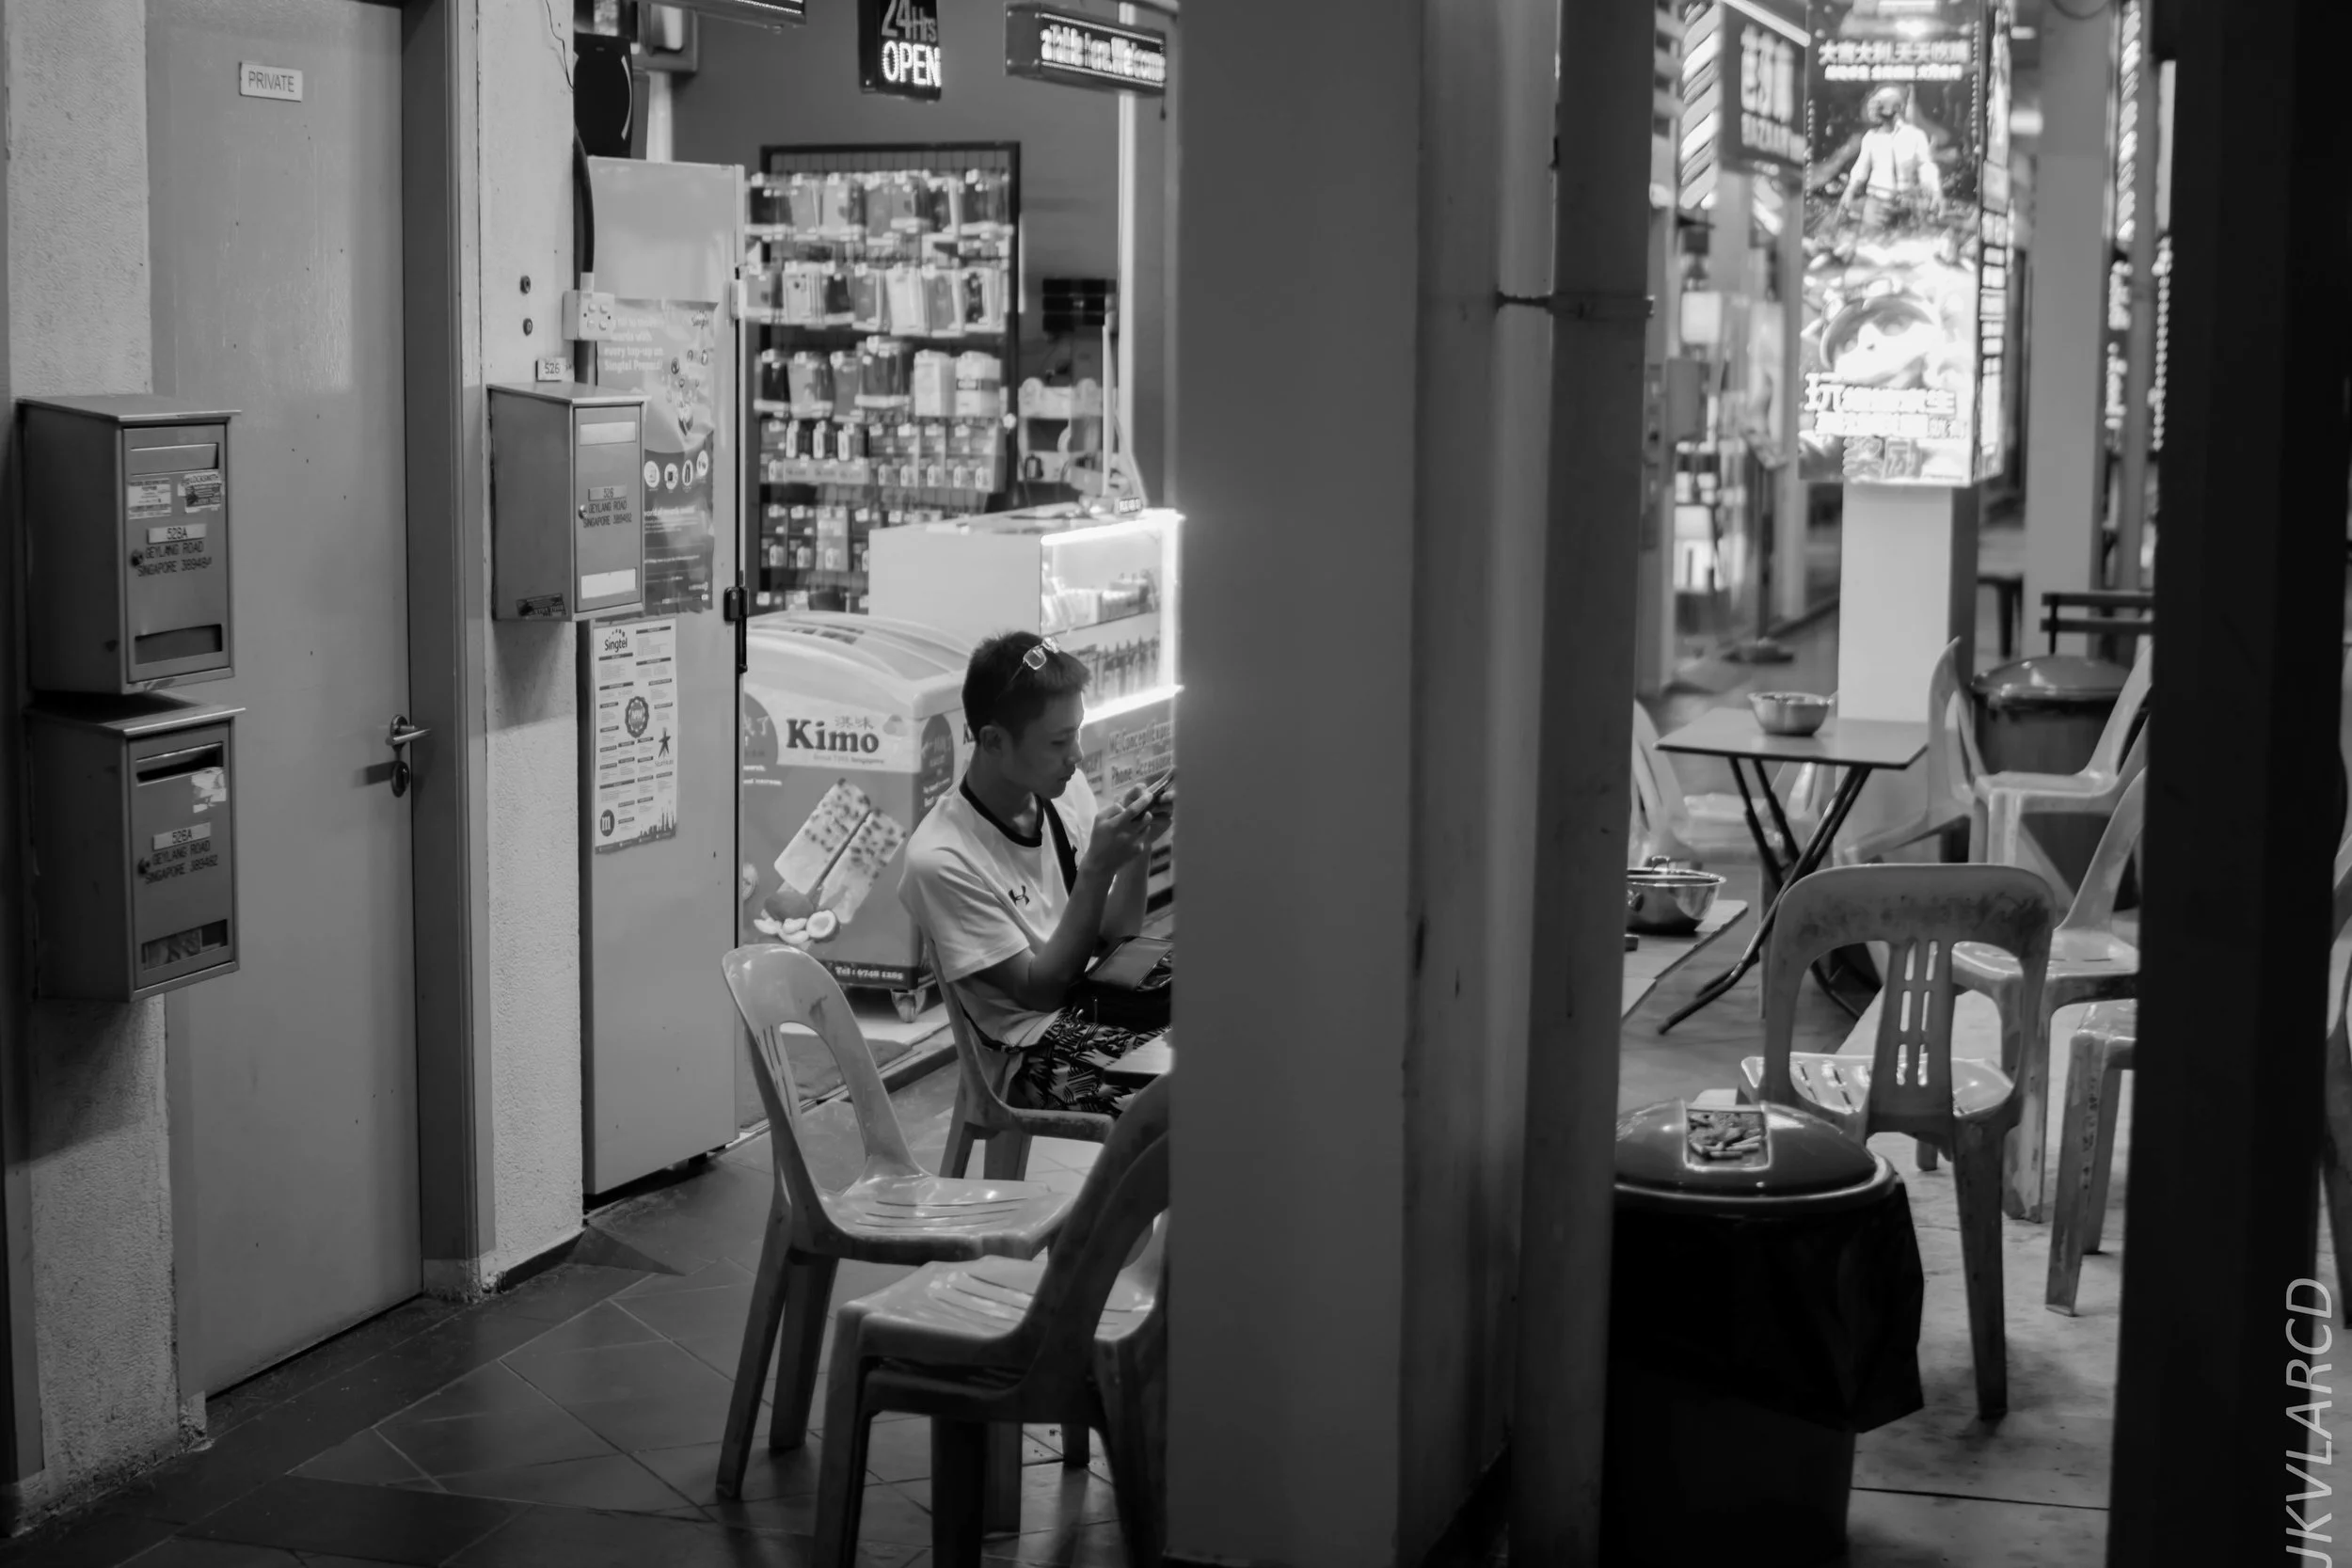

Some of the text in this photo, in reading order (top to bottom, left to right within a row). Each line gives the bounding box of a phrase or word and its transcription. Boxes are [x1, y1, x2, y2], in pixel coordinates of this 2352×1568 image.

[882, 40, 941, 87] OPEN
[247, 70, 294, 93] PRIVATE
[544, 361, 561, 375] 526
[603, 487, 614, 499] 526
[588, 499, 628, 514] GEYLANG ROAD
[582, 515, 612, 528] SINGAPORE
[145, 541, 204, 559] GEYLANG ROAD
[136, 561, 178, 577] SINGAPORE
[604, 638, 628, 654] Singtel
[786, 718, 880, 753] Kimo
[1110, 765, 1132, 785] Phone
[152, 840, 211, 865] GEYLANG ROAD
[145, 863, 185, 884] SINGAPORE
